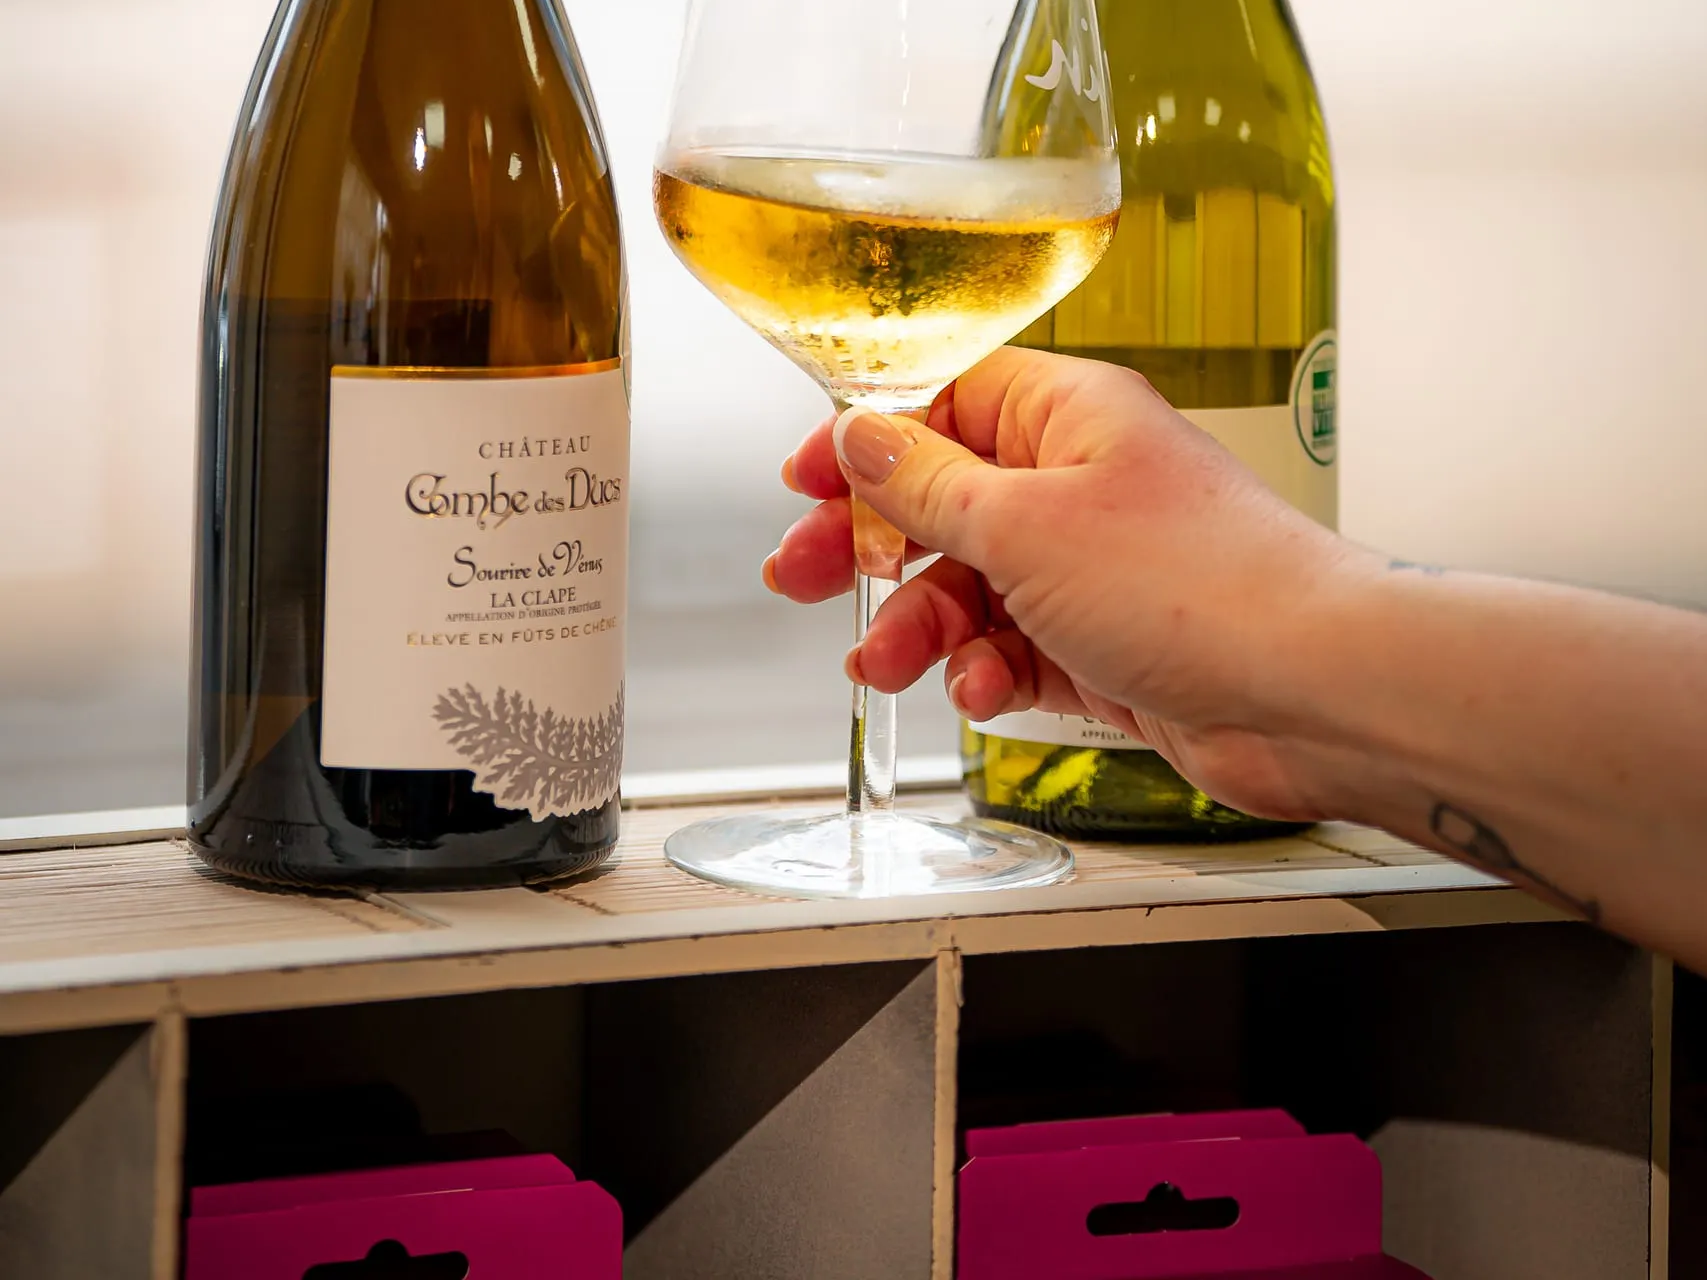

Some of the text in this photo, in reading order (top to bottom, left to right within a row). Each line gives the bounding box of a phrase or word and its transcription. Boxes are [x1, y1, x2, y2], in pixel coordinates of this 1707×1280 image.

[478, 436, 592, 459] CHÂTEAU
[405, 467, 621, 530] Combe des Ducs
[447, 539, 602, 588] Sourire de Vénus
[490, 587, 576, 608] LA CLAPE
[446, 611, 514, 622] APPELLATION
[478, 633, 503, 645] EN
[511, 628, 554, 643] FÛTS
[560, 625, 578, 639] DE
[1081, 731, 1130, 741] APPELLA
